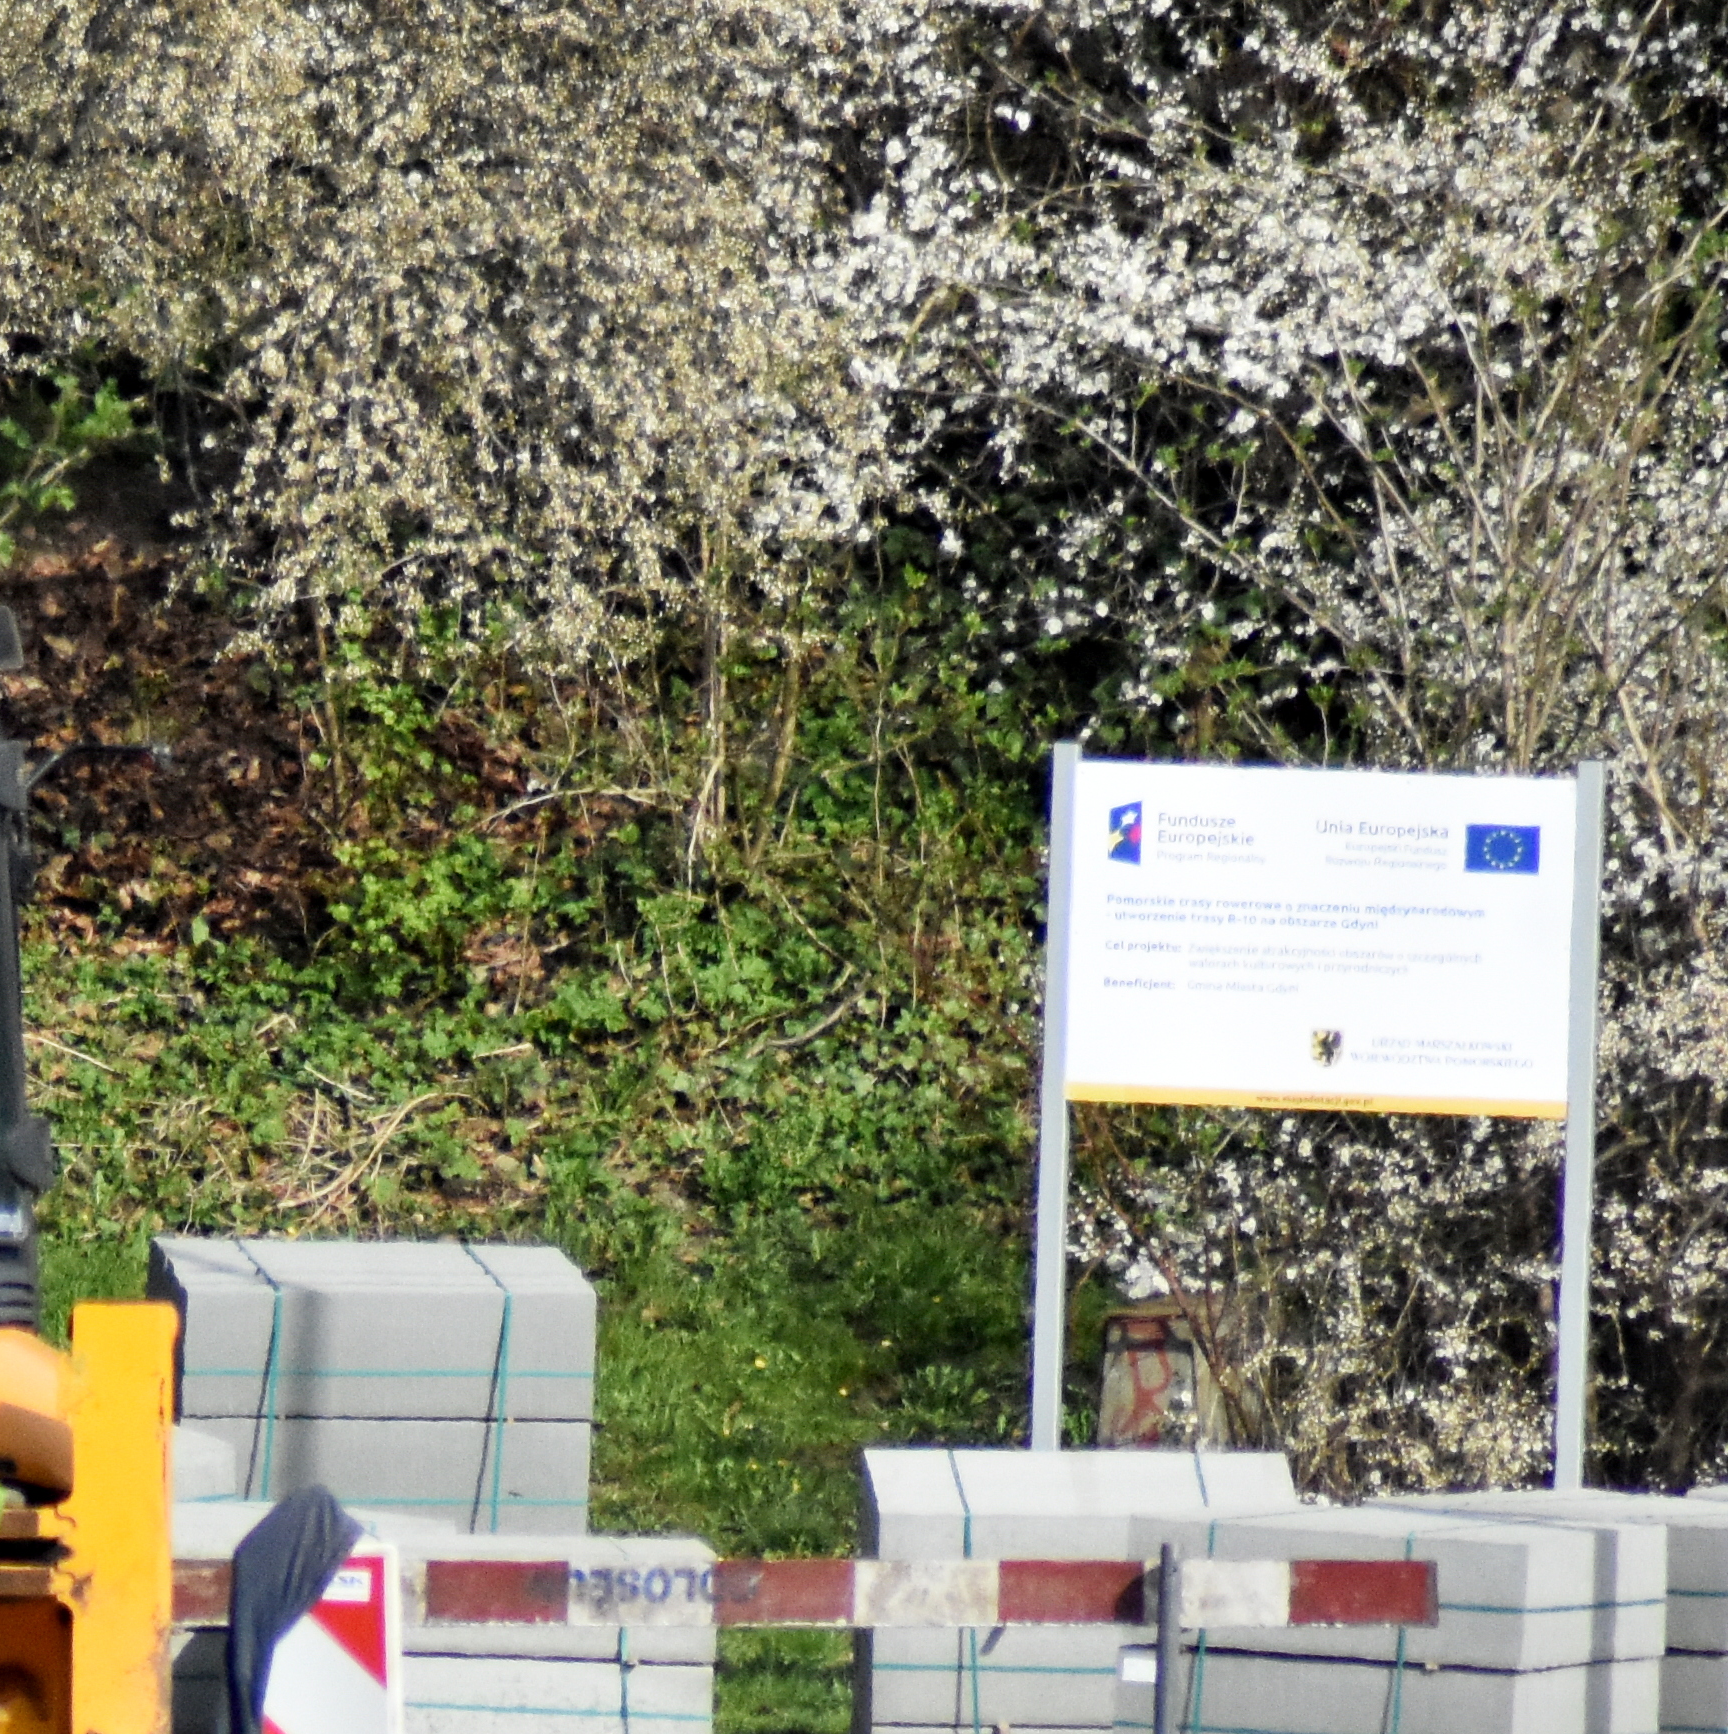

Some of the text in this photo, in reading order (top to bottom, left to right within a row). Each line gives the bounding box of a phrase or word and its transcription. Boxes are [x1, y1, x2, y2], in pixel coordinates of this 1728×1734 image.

[1158, 812, 1237, 829] Fundusze
[1316, 819, 1449, 841] Unia Europejska
[1157, 829, 1255, 848] Europejskie
[1156, 850, 1266, 866] Program Regionalny
[1107, 894, 1176, 907] Pomorskie
[1179, 898, 1213, 910] trasy
[1216, 899, 1282, 911] rowerowe
[1297, 902, 1361, 914] znaczeniu
[1114, 911, 1187, 922] utworzenie
[1191, 912, 1225, 925] trasy
[1261, 917, 1276, 927] na
[1279, 917, 1338, 929] obszarze
[1341, 919, 1379, 932] Gdyni
[1105, 940, 1125, 951] Cel
[1127, 941, 1182, 953] projektu:
[1103, 976, 1299, 995] Beneficjent: Gmina Miasta Gdyni
